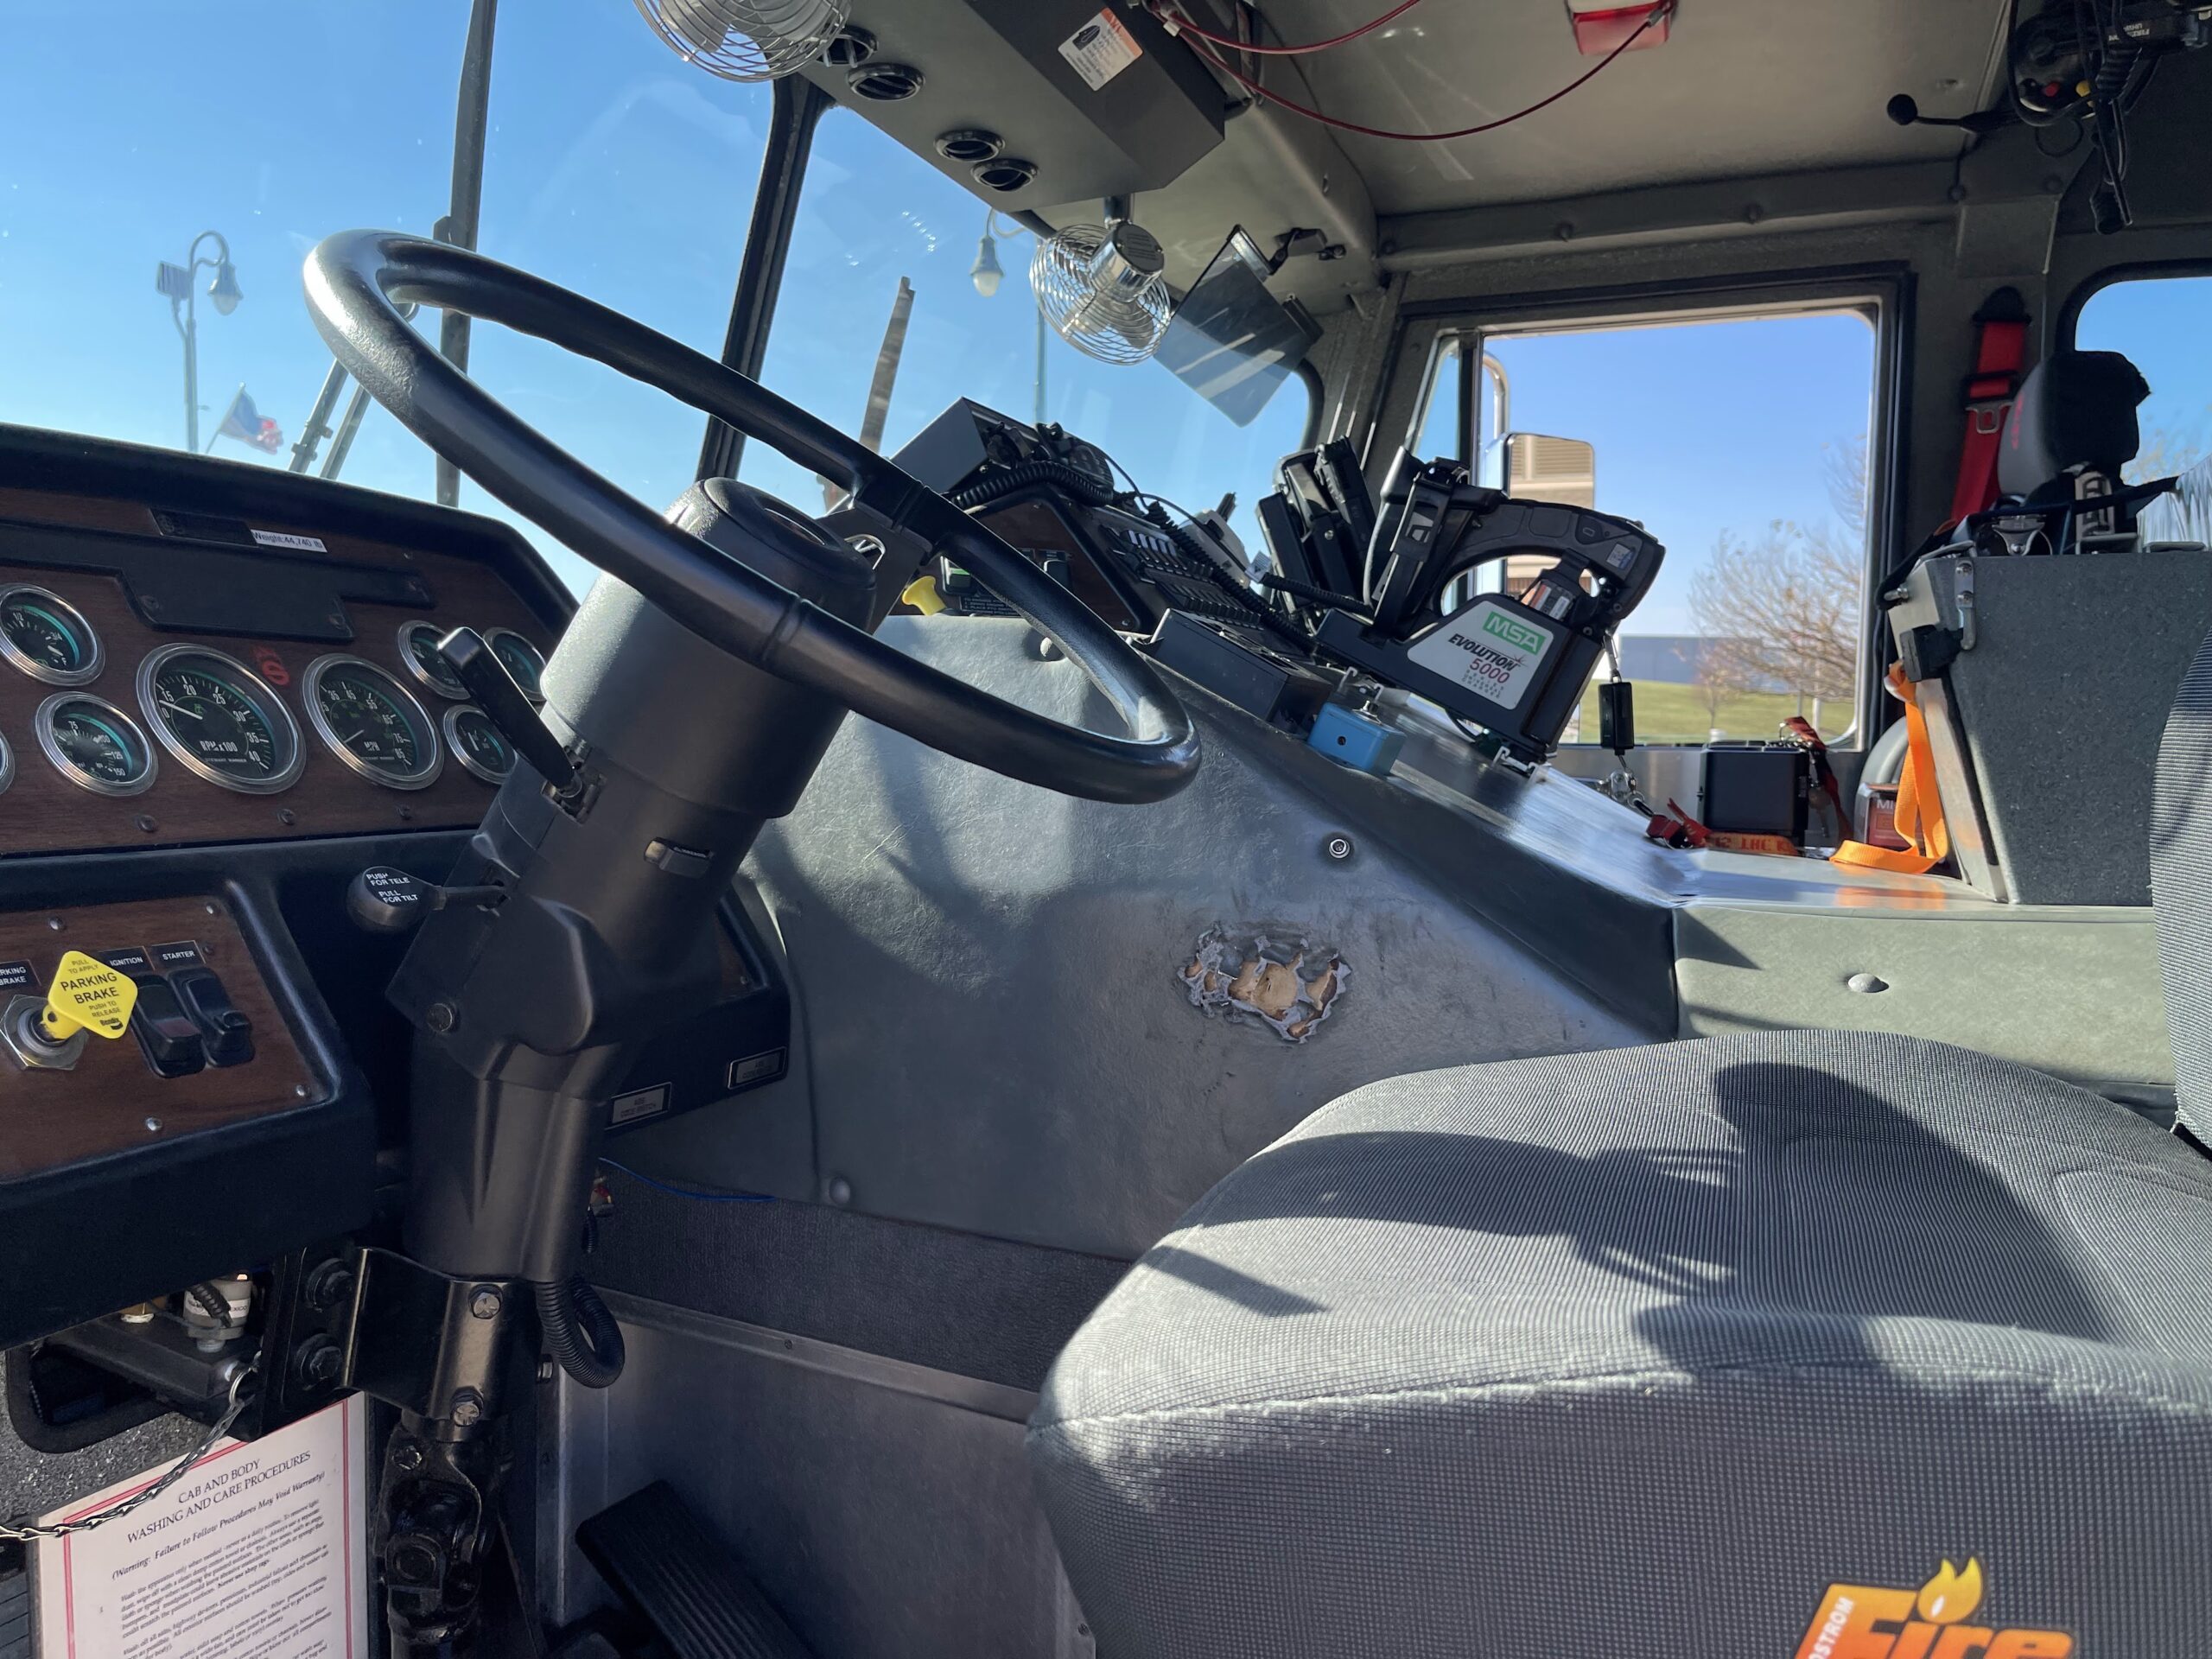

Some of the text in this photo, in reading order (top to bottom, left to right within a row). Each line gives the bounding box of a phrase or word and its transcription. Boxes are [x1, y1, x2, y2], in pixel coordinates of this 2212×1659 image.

[1487, 616, 1539, 652] MSA
[1448, 634, 1521, 671] EVOLUTION
[1470, 658, 1510, 683] 5000
[183, 684, 197, 696] 20
[346, 690, 357, 700] 45
[162, 691, 175, 702] 15
[213, 693, 226, 705] 25
[366, 700, 378, 709] 55
[232, 711, 246, 721] 30
[383, 715, 393, 725] 65
[68, 721, 79, 729] 75
[247, 733, 260, 744] 35
[393, 734, 404, 743] 75
[364, 741, 380, 751] MPH
[111, 751, 124, 760] 125
[248, 751, 261, 762] 40
[395, 748, 405, 759] 85
[162, 950, 195, 961] STARTER
[110, 957, 143, 966] IGNITION
[0, 967, 26, 976] RKING
[79, 964, 99, 973] APPLY
[0, 976, 27, 986] BRAKE
[60, 973, 118, 991] PARKING
[74, 987, 119, 1004] BRAKE
[92, 1008, 121, 1018] RELEASE
[178, 1459, 261, 1504] CAB AND BODY
[127, 1451, 311, 1544] WASHING AND CARE PROCEDURES
[111, 1556, 151, 1580] (Warning:
[156, 1541, 181, 1560] Failure
[182, 1537, 191, 1546] to
[193, 1524, 219, 1541] Follow
[219, 1506, 257, 1529] Procedures
[257, 1497, 274, 1510] May
[276, 1487, 291, 1500] Void
[292, 1471, 326, 1492] Warranty)
